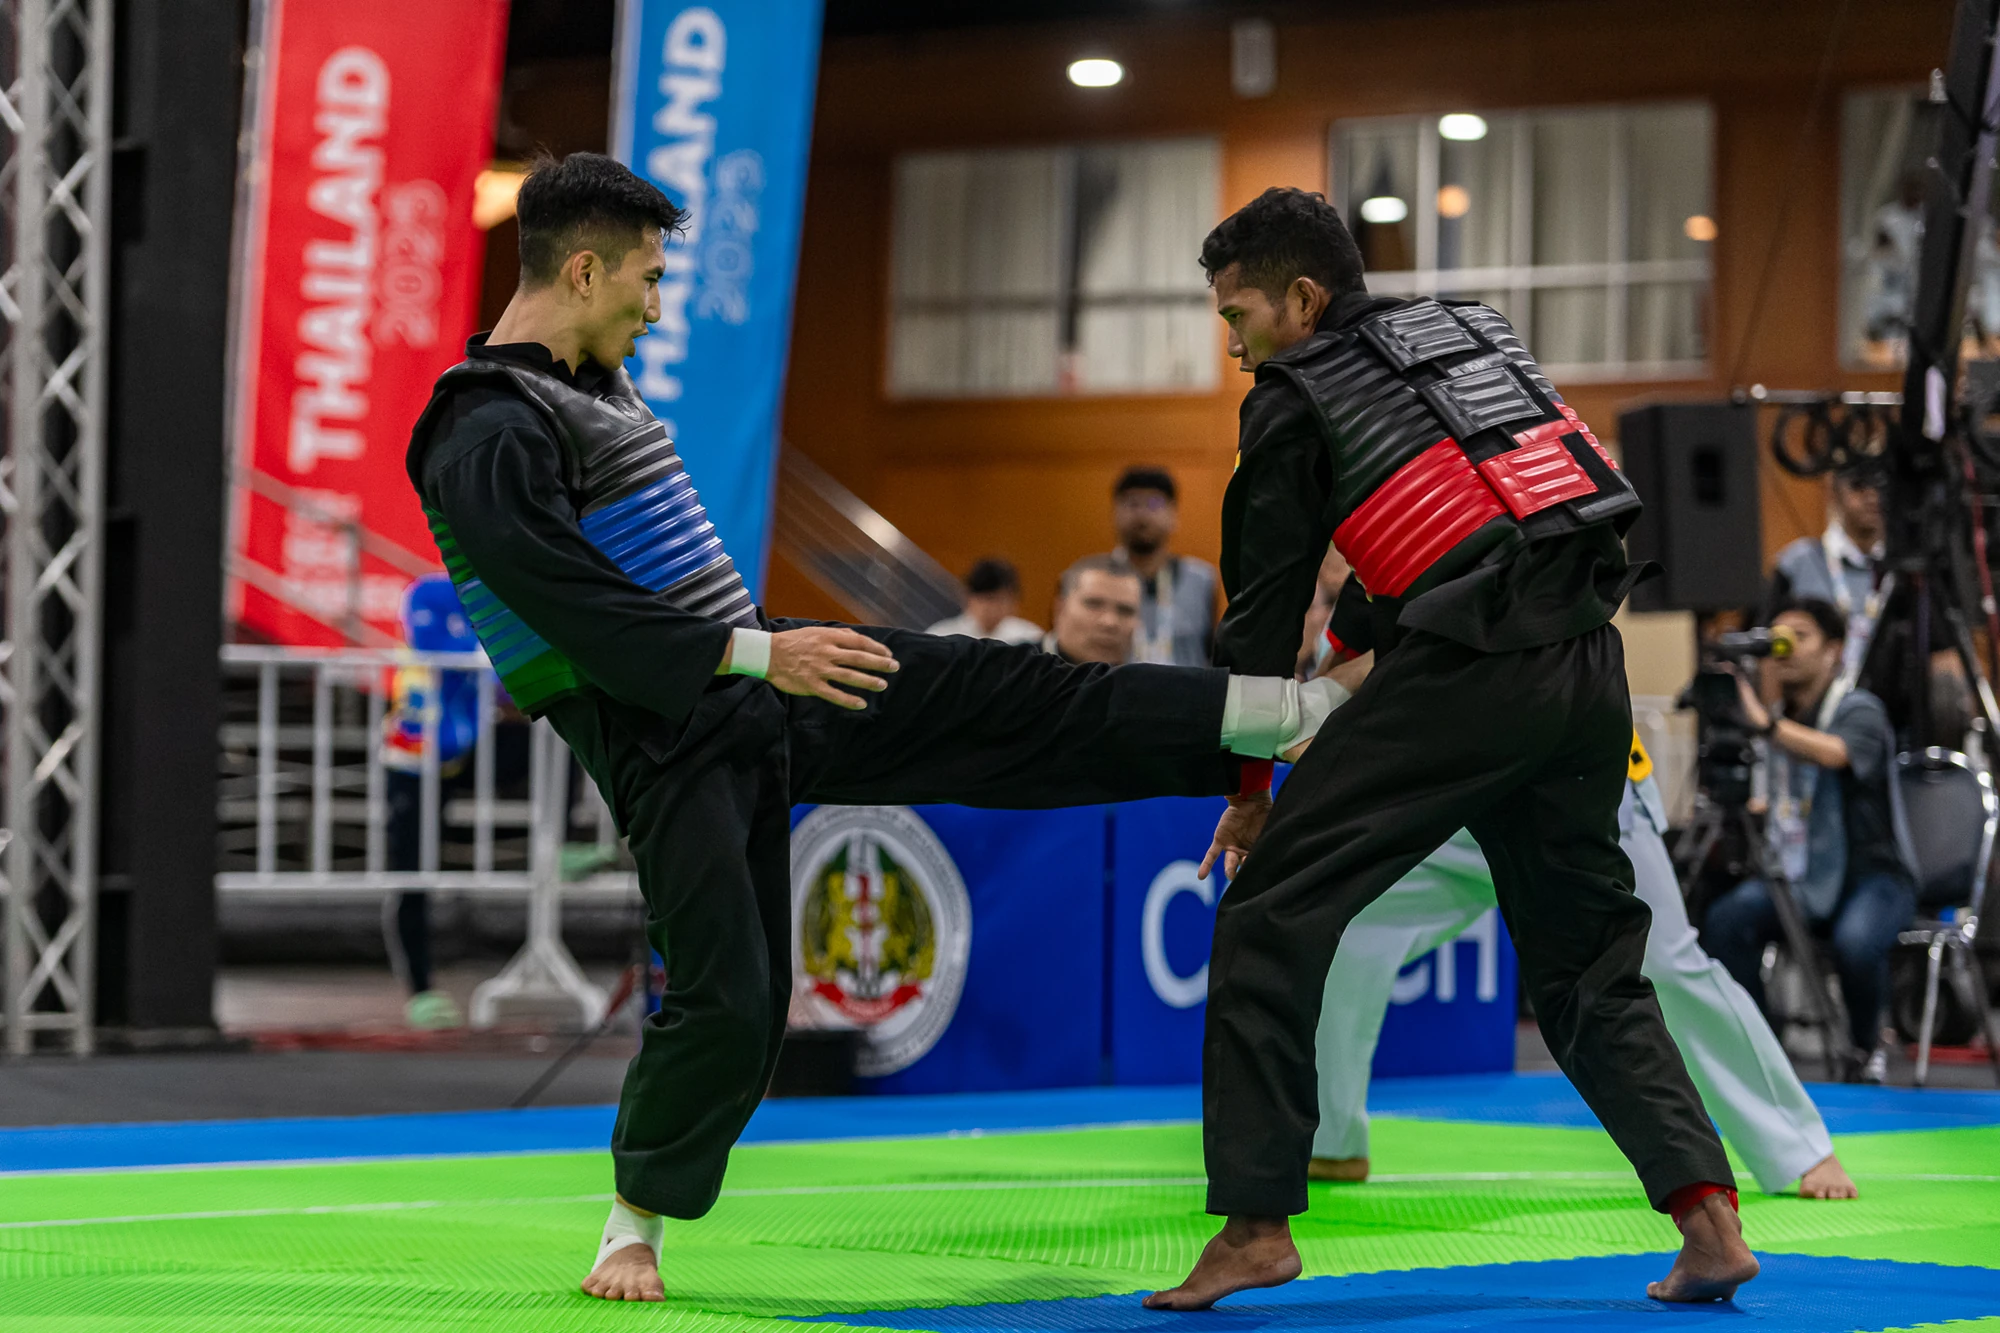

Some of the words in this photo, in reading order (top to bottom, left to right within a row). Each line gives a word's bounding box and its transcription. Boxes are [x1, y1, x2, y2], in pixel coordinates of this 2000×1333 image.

[288, 46, 391, 473] THAILAND
[371, 178, 448, 349] 2025
[700, 149, 766, 325] 2025
